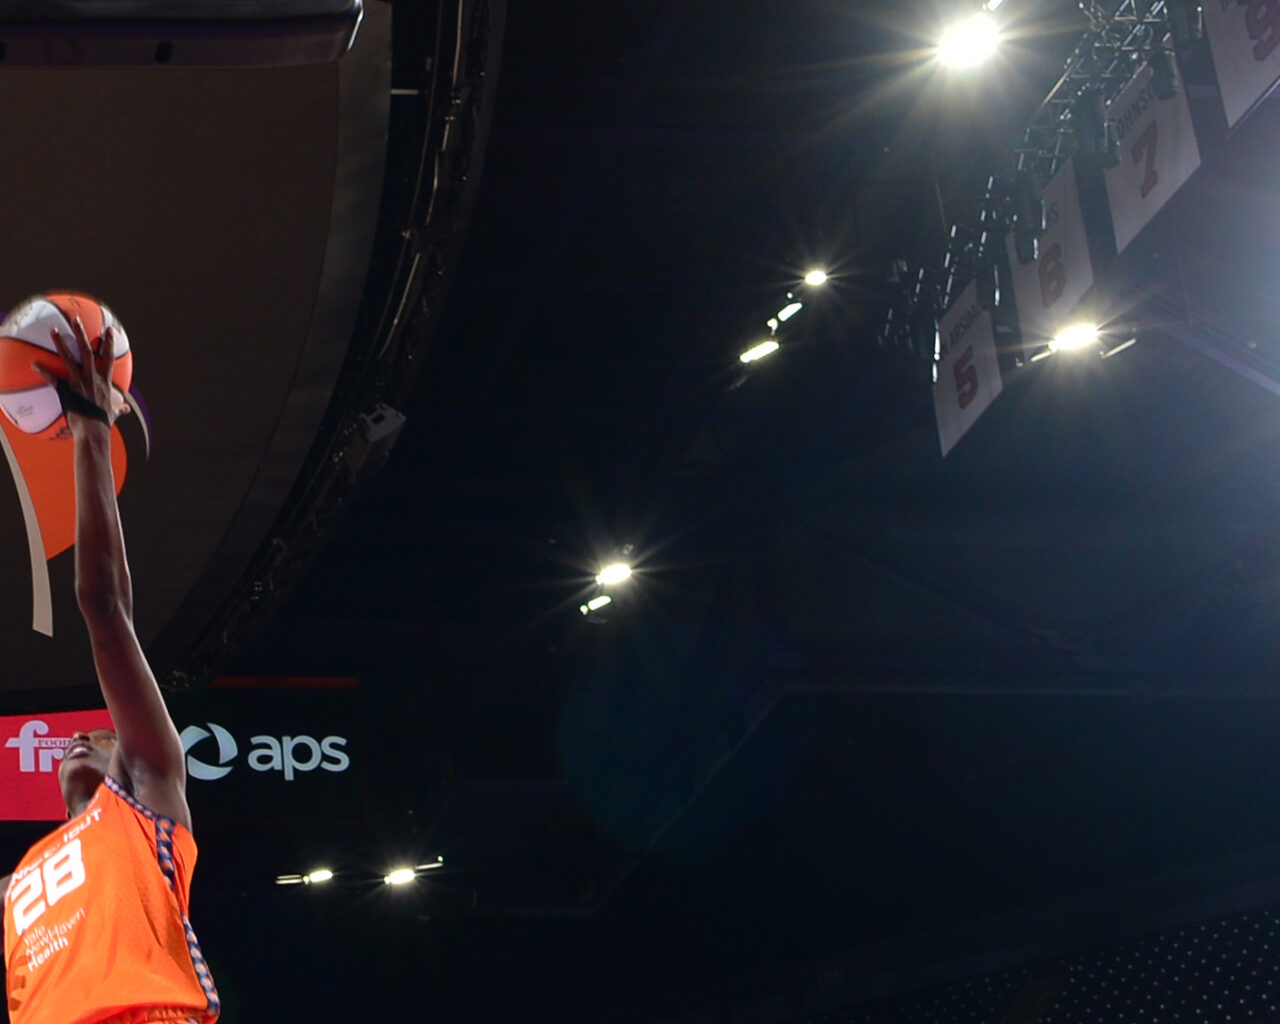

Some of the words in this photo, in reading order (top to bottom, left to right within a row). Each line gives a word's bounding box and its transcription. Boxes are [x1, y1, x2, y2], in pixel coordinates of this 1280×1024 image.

[1131, 119, 1159, 198] 7
[1039, 243, 1066, 308] 6
[953, 348, 978, 409] 5
[248, 735, 350, 781] aps
[10, 838, 86, 936] 28
[24, 924, 46, 945] Yale
[28, 935, 69, 972] Health
